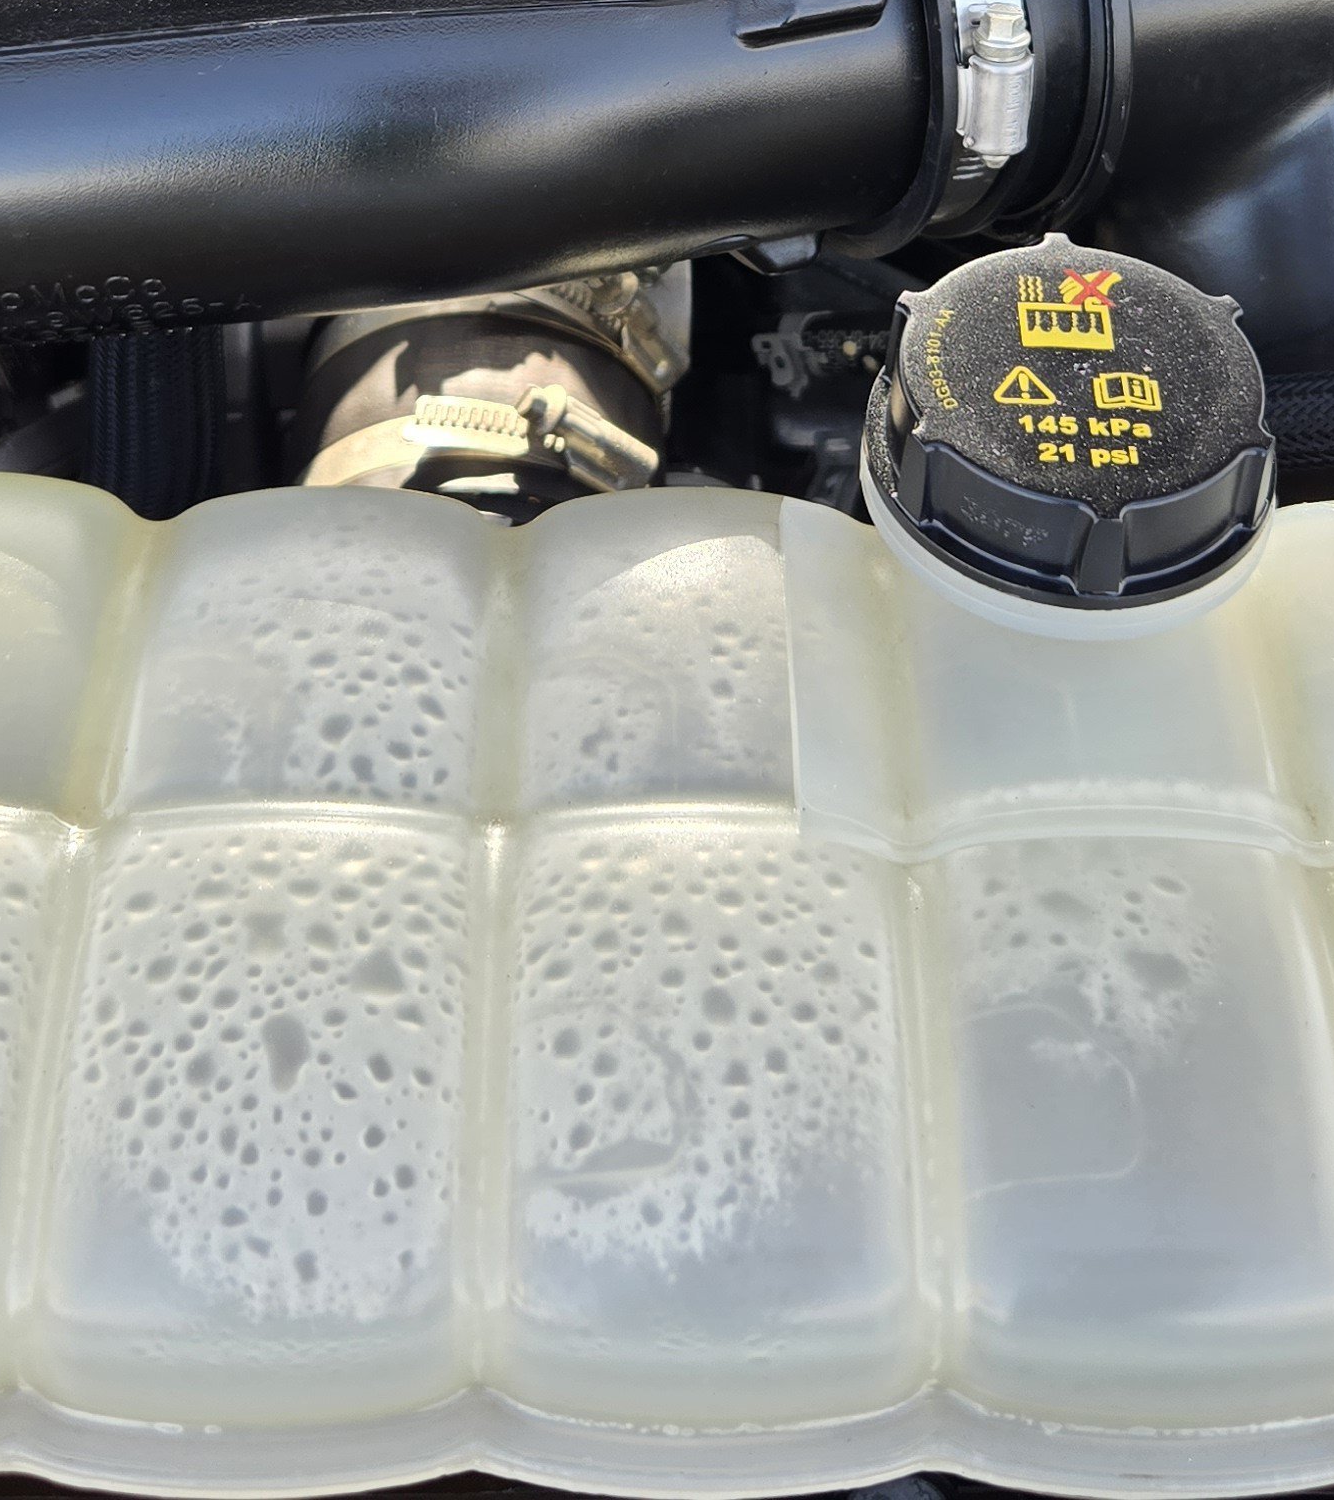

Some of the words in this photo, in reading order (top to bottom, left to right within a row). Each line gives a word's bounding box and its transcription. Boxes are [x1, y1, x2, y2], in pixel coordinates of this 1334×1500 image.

[1018, 416, 1079, 435] 145
[1089, 418, 1152, 437] kPa
[1038, 443, 1075, 462] 21
[1091, 446, 1139, 468] psi
